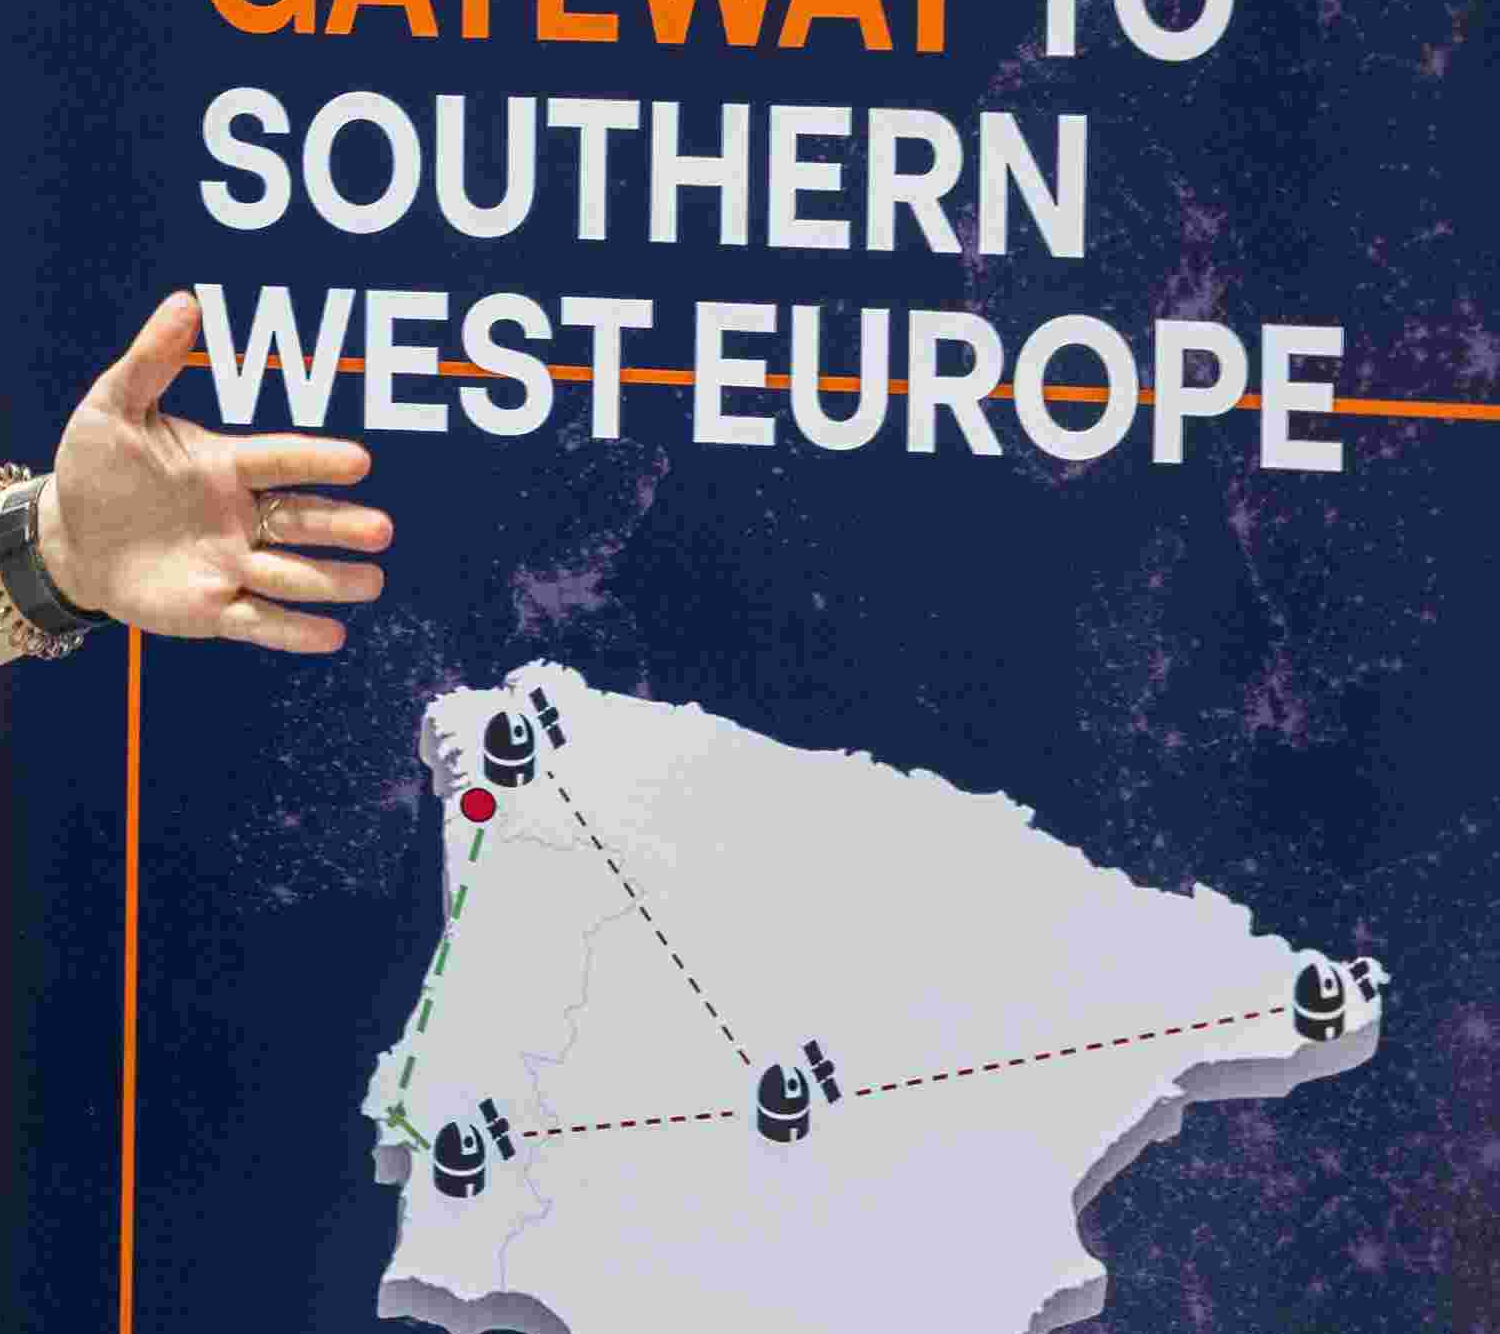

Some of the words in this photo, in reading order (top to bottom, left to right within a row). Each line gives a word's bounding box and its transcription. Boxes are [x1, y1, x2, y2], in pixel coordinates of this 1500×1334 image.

[200, 87, 1088, 259] SOUTHERN
[194, 283, 654, 440] WEST
[692, 301, 1345, 473] EUROPE
